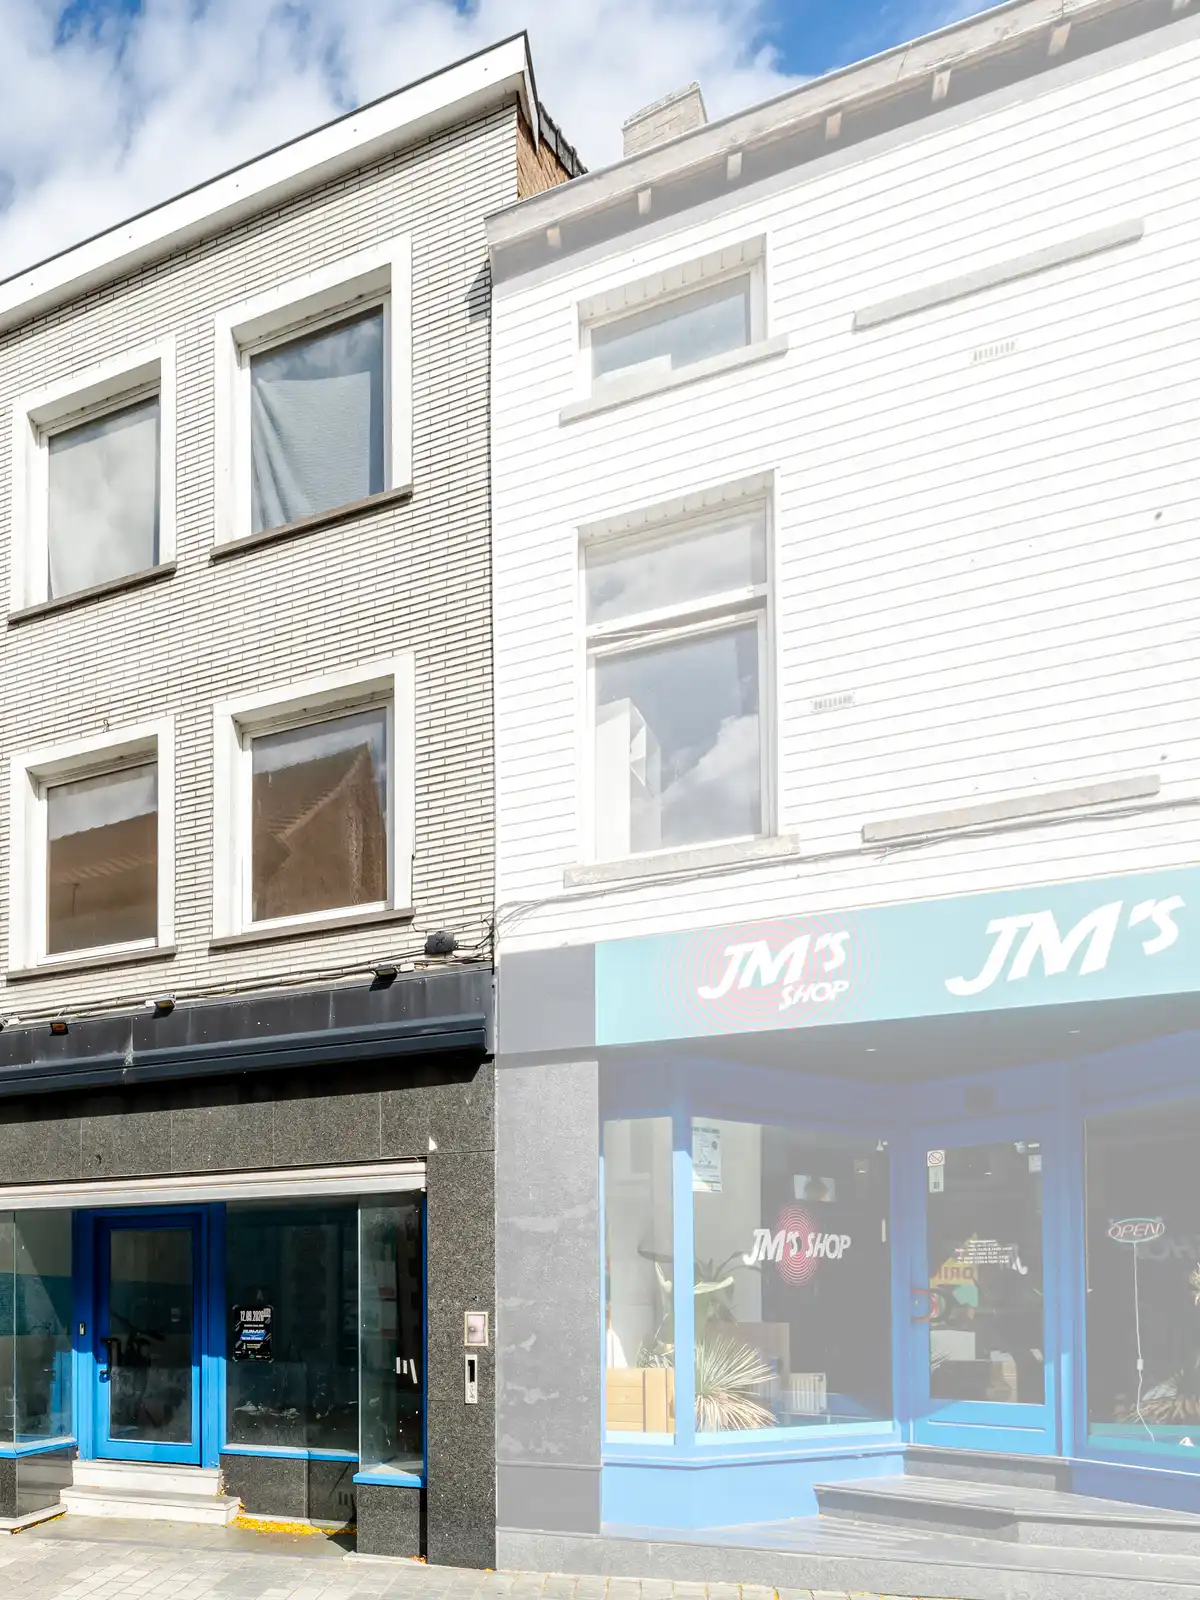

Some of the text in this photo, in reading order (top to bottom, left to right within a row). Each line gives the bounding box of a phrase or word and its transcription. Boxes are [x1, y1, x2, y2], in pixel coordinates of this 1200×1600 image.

[778, 979, 850, 1011] SHOP
[1108, 1223, 1161, 1239] OPEN
[805, 1232, 852, 1260] SHOP
